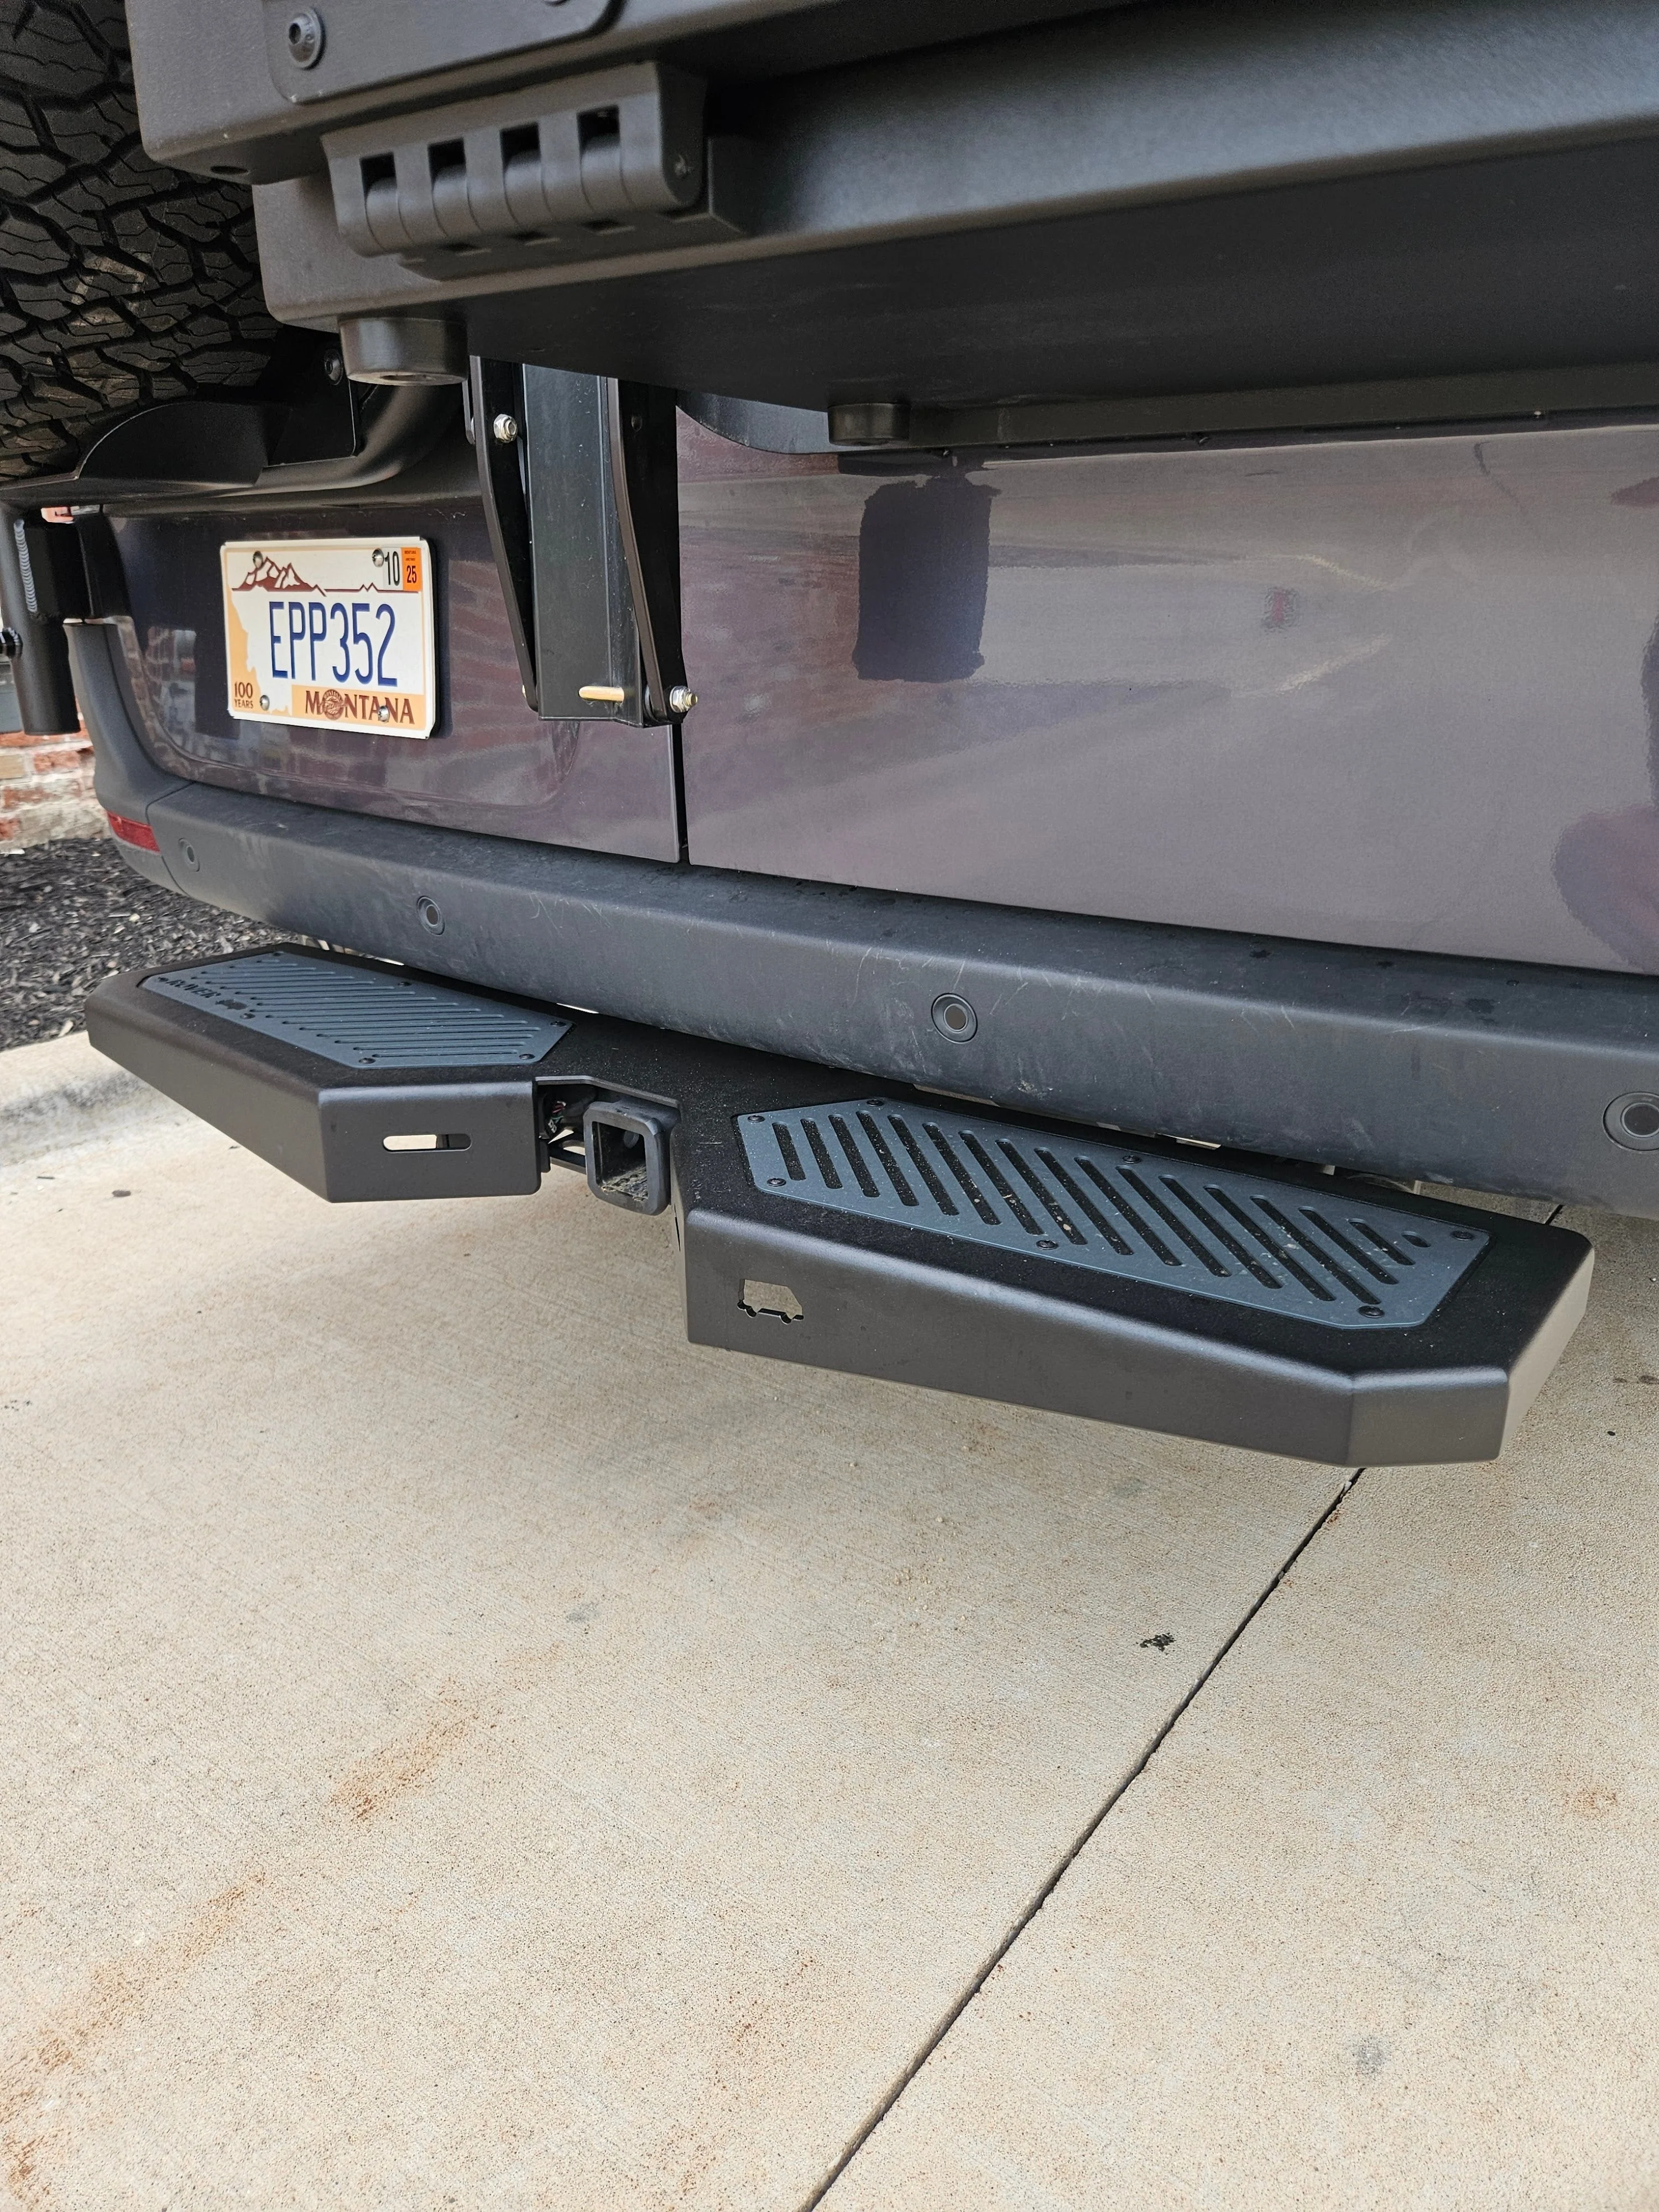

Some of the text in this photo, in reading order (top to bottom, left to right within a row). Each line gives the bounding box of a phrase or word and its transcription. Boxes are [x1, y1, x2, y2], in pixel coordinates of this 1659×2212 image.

[385, 551, 400, 586] 10
[406, 565, 417, 583] 25
[269, 601, 398, 687] EPP352
[234, 681, 253, 699] 100
[234, 698, 254, 709] YEARS
[305, 689, 415, 725] MONTANA
